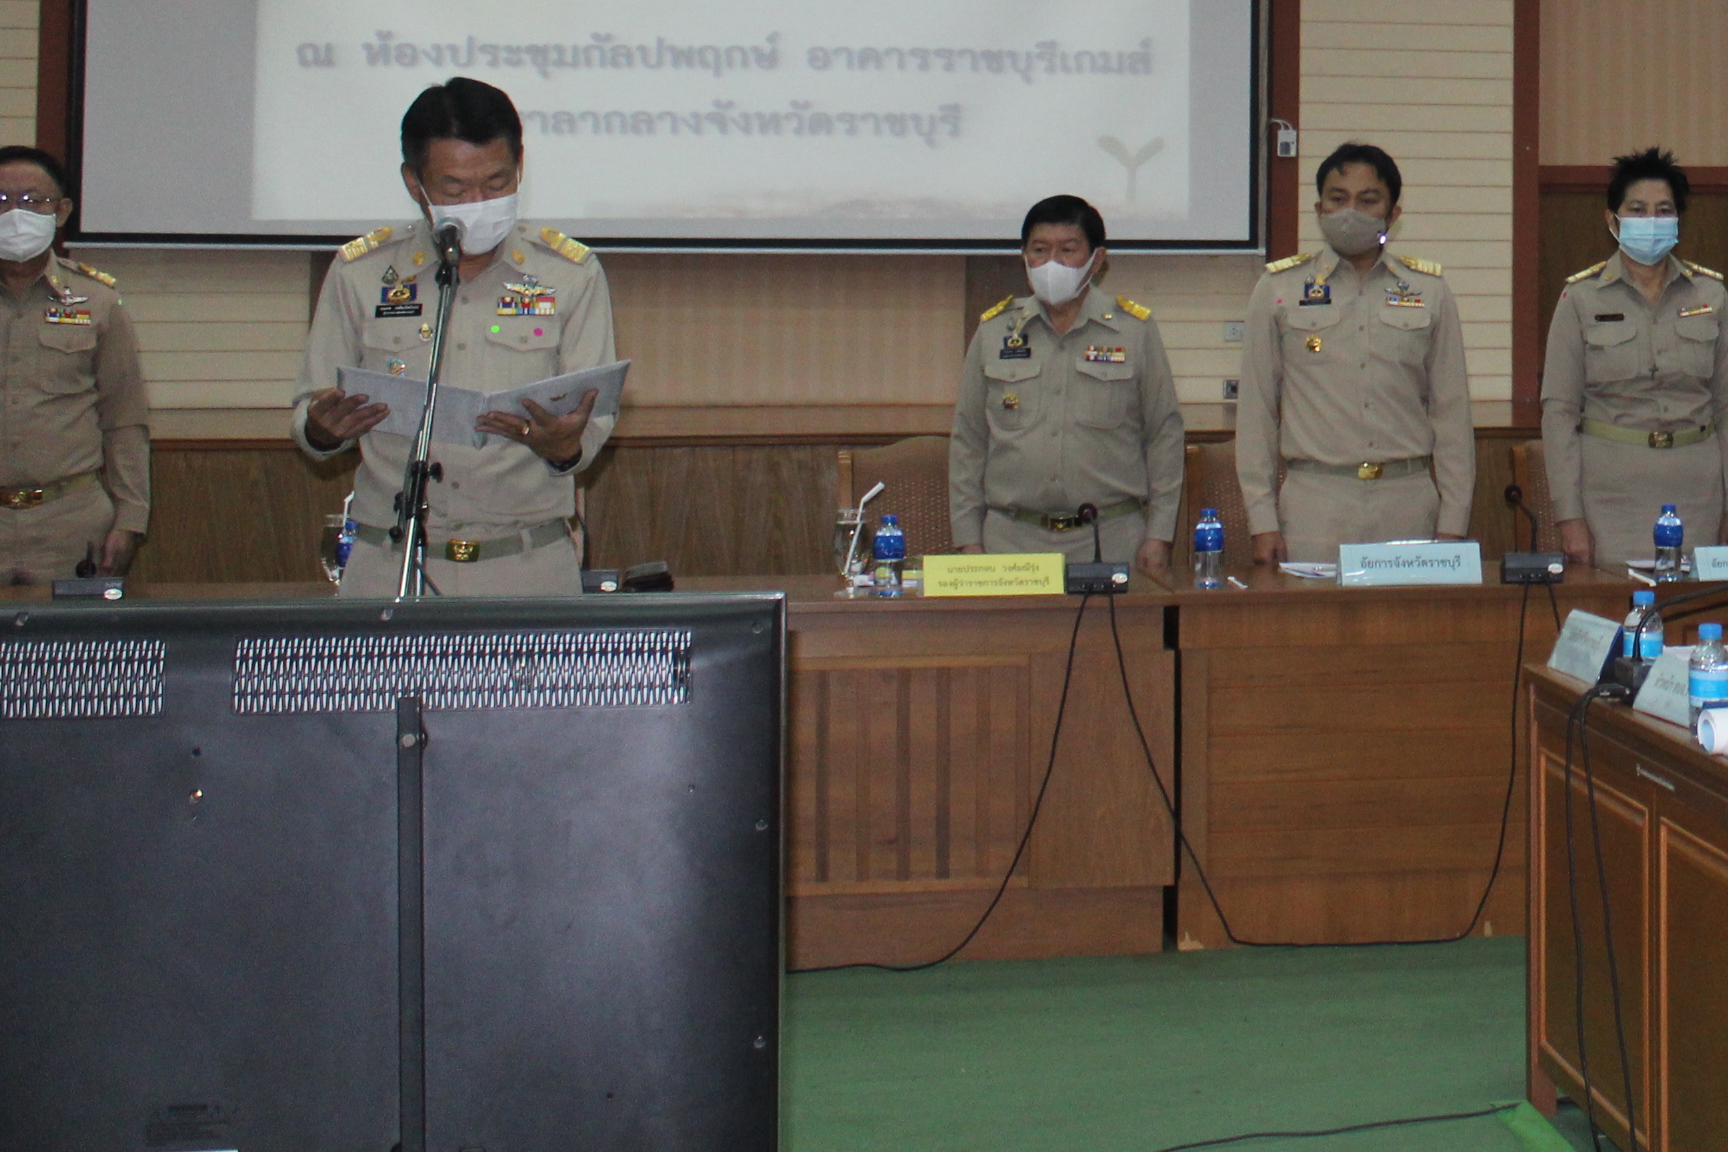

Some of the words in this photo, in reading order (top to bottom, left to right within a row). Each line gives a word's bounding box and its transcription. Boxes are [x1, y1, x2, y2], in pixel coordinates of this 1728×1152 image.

[297, 41, 336, 68] ณ
[361, 30, 780, 80] ห้องประชุมกัลปพฤกษ์
[807, 37, 1153, 85] อาคารราชบุรีเกมส์
[518, 100, 963, 149] าลากลางจังหวัดราชบุรี
[1360, 555, 1461, 570] อัยการจังหวัดราชบุรี
